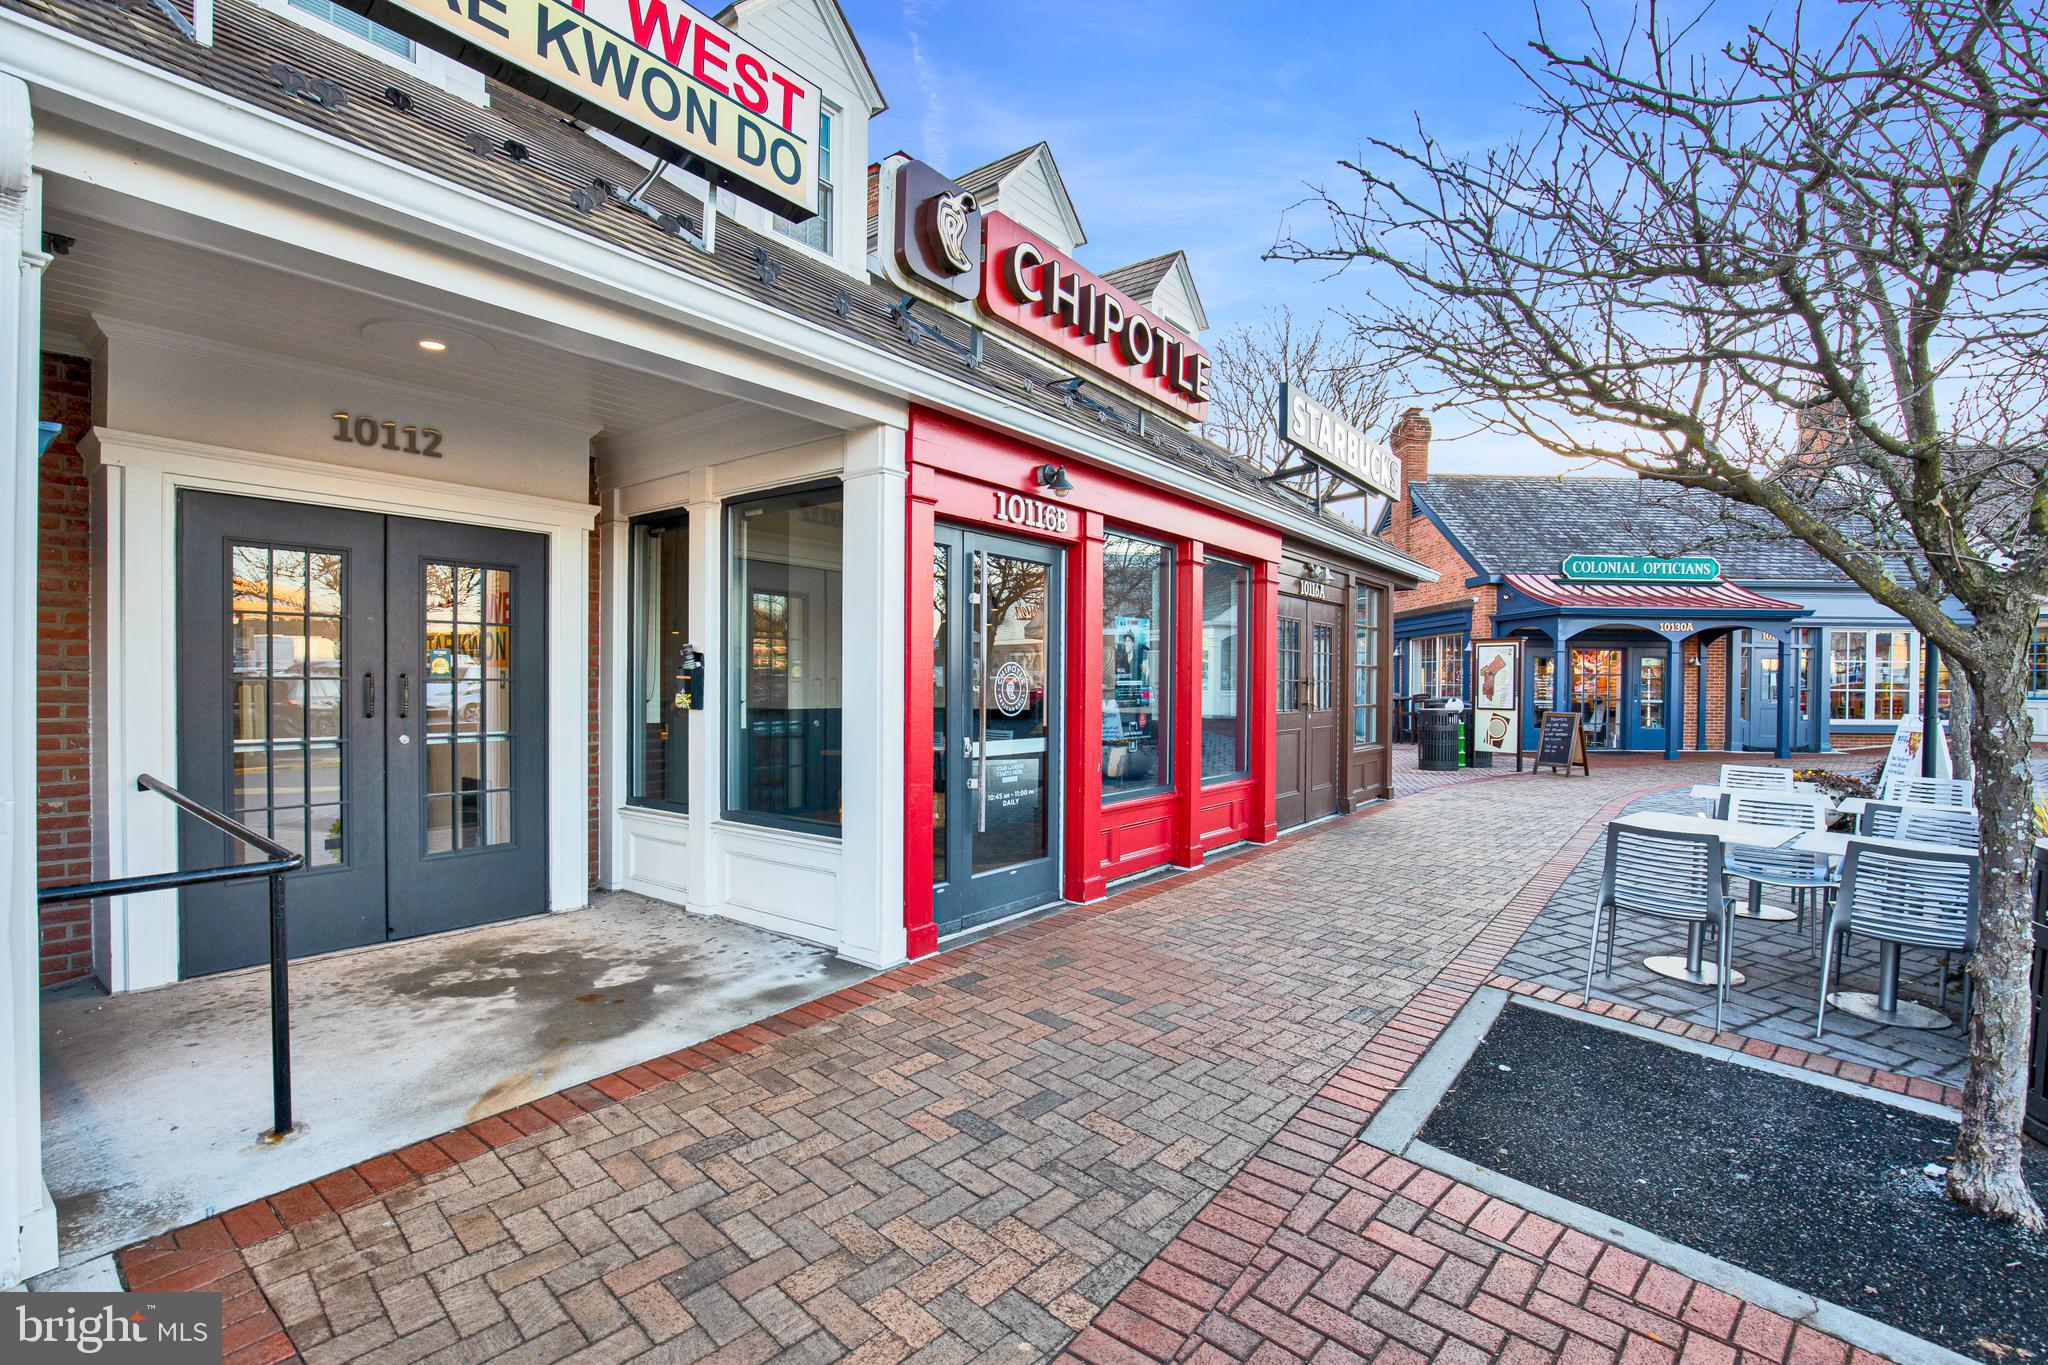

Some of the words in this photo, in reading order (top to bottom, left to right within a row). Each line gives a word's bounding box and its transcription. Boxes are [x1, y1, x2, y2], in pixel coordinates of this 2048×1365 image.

[628, 0, 805, 133] WEST
[537, 2, 718, 146] KWON
[737, 114, 801, 186] DO
[1006, 241, 1211, 402] CHIPOTLE
[333, 412, 442, 458] 10112
[1292, 395, 1399, 494] STARBUCKS
[995, 491, 1068, 533] 10116B
[1572, 560, 1639, 574] COLONIAL
[1643, 561, 1711, 576] OPTICIANS
[1300, 580, 1326, 599] 10116A
[1659, 622, 1694, 632] 10130A
[997, 665, 1026, 685] CHIPOTLE
[987, 793, 1003, 801] 10:45
[1014, 789, 1028, 797] 11:00
[1002, 798, 1020, 807] DAILY
